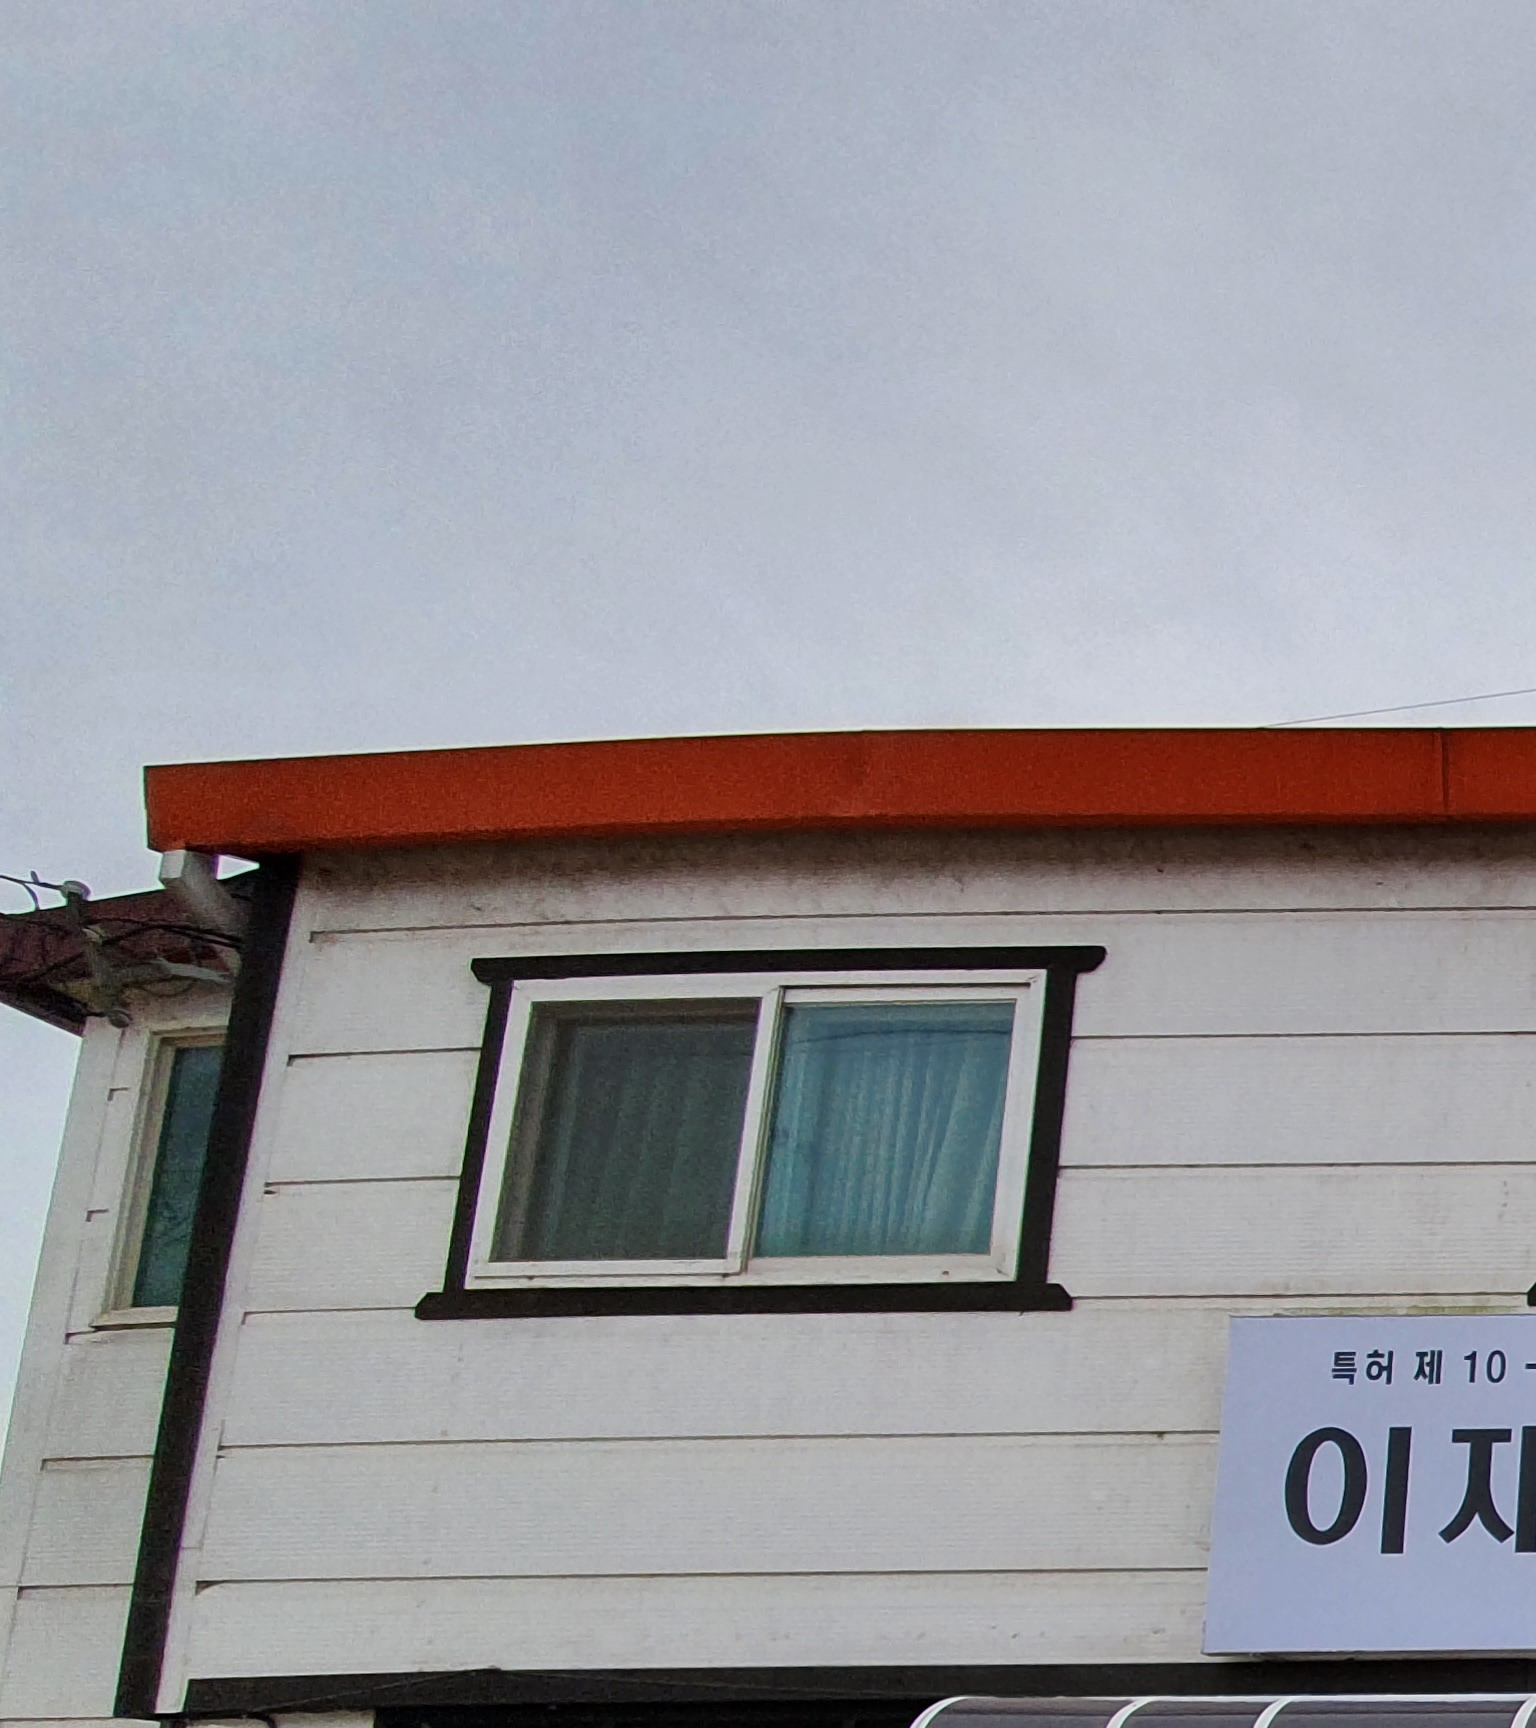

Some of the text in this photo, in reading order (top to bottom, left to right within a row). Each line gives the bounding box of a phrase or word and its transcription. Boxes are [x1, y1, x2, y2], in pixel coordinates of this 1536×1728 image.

[1331, 1349, 1394, 1386] 특허
[1413, 1349, 1443, 1385] 제
[1463, 1349, 1507, 1384] 10
